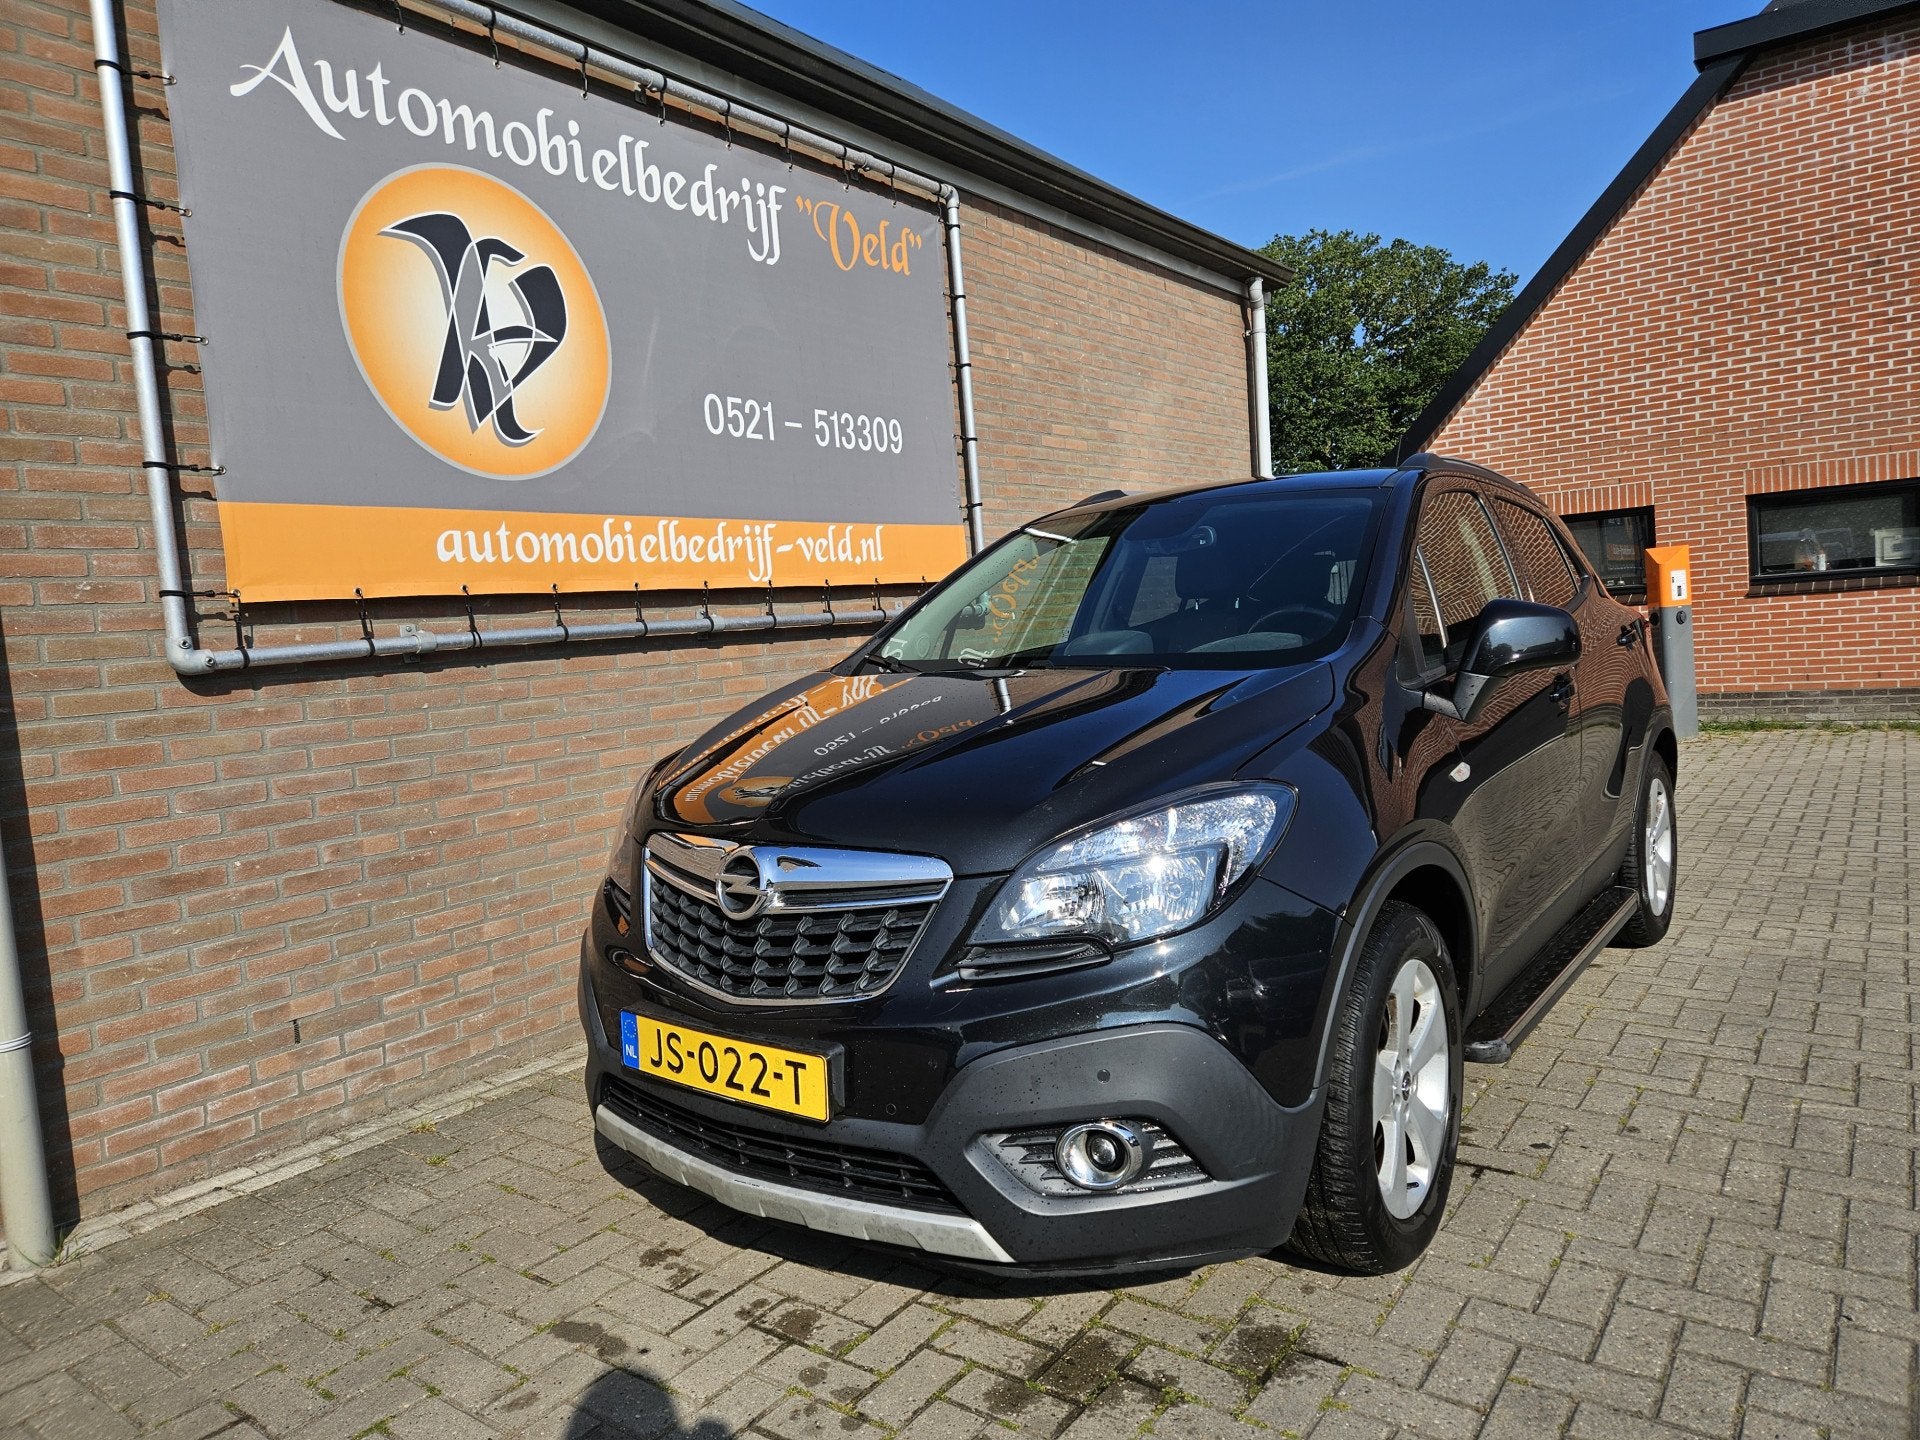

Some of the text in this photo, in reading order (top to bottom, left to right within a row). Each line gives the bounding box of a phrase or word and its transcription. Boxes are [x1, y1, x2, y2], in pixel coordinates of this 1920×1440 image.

[230, 25, 787, 265] Automobielbedrijf
[703, 393, 775, 441] 0521
[814, 408, 903, 454] 513309
[436, 518, 885, 582] automobielbedrijf-veld.nl
[625, 1028, 807, 1105] NL JS-022-T
